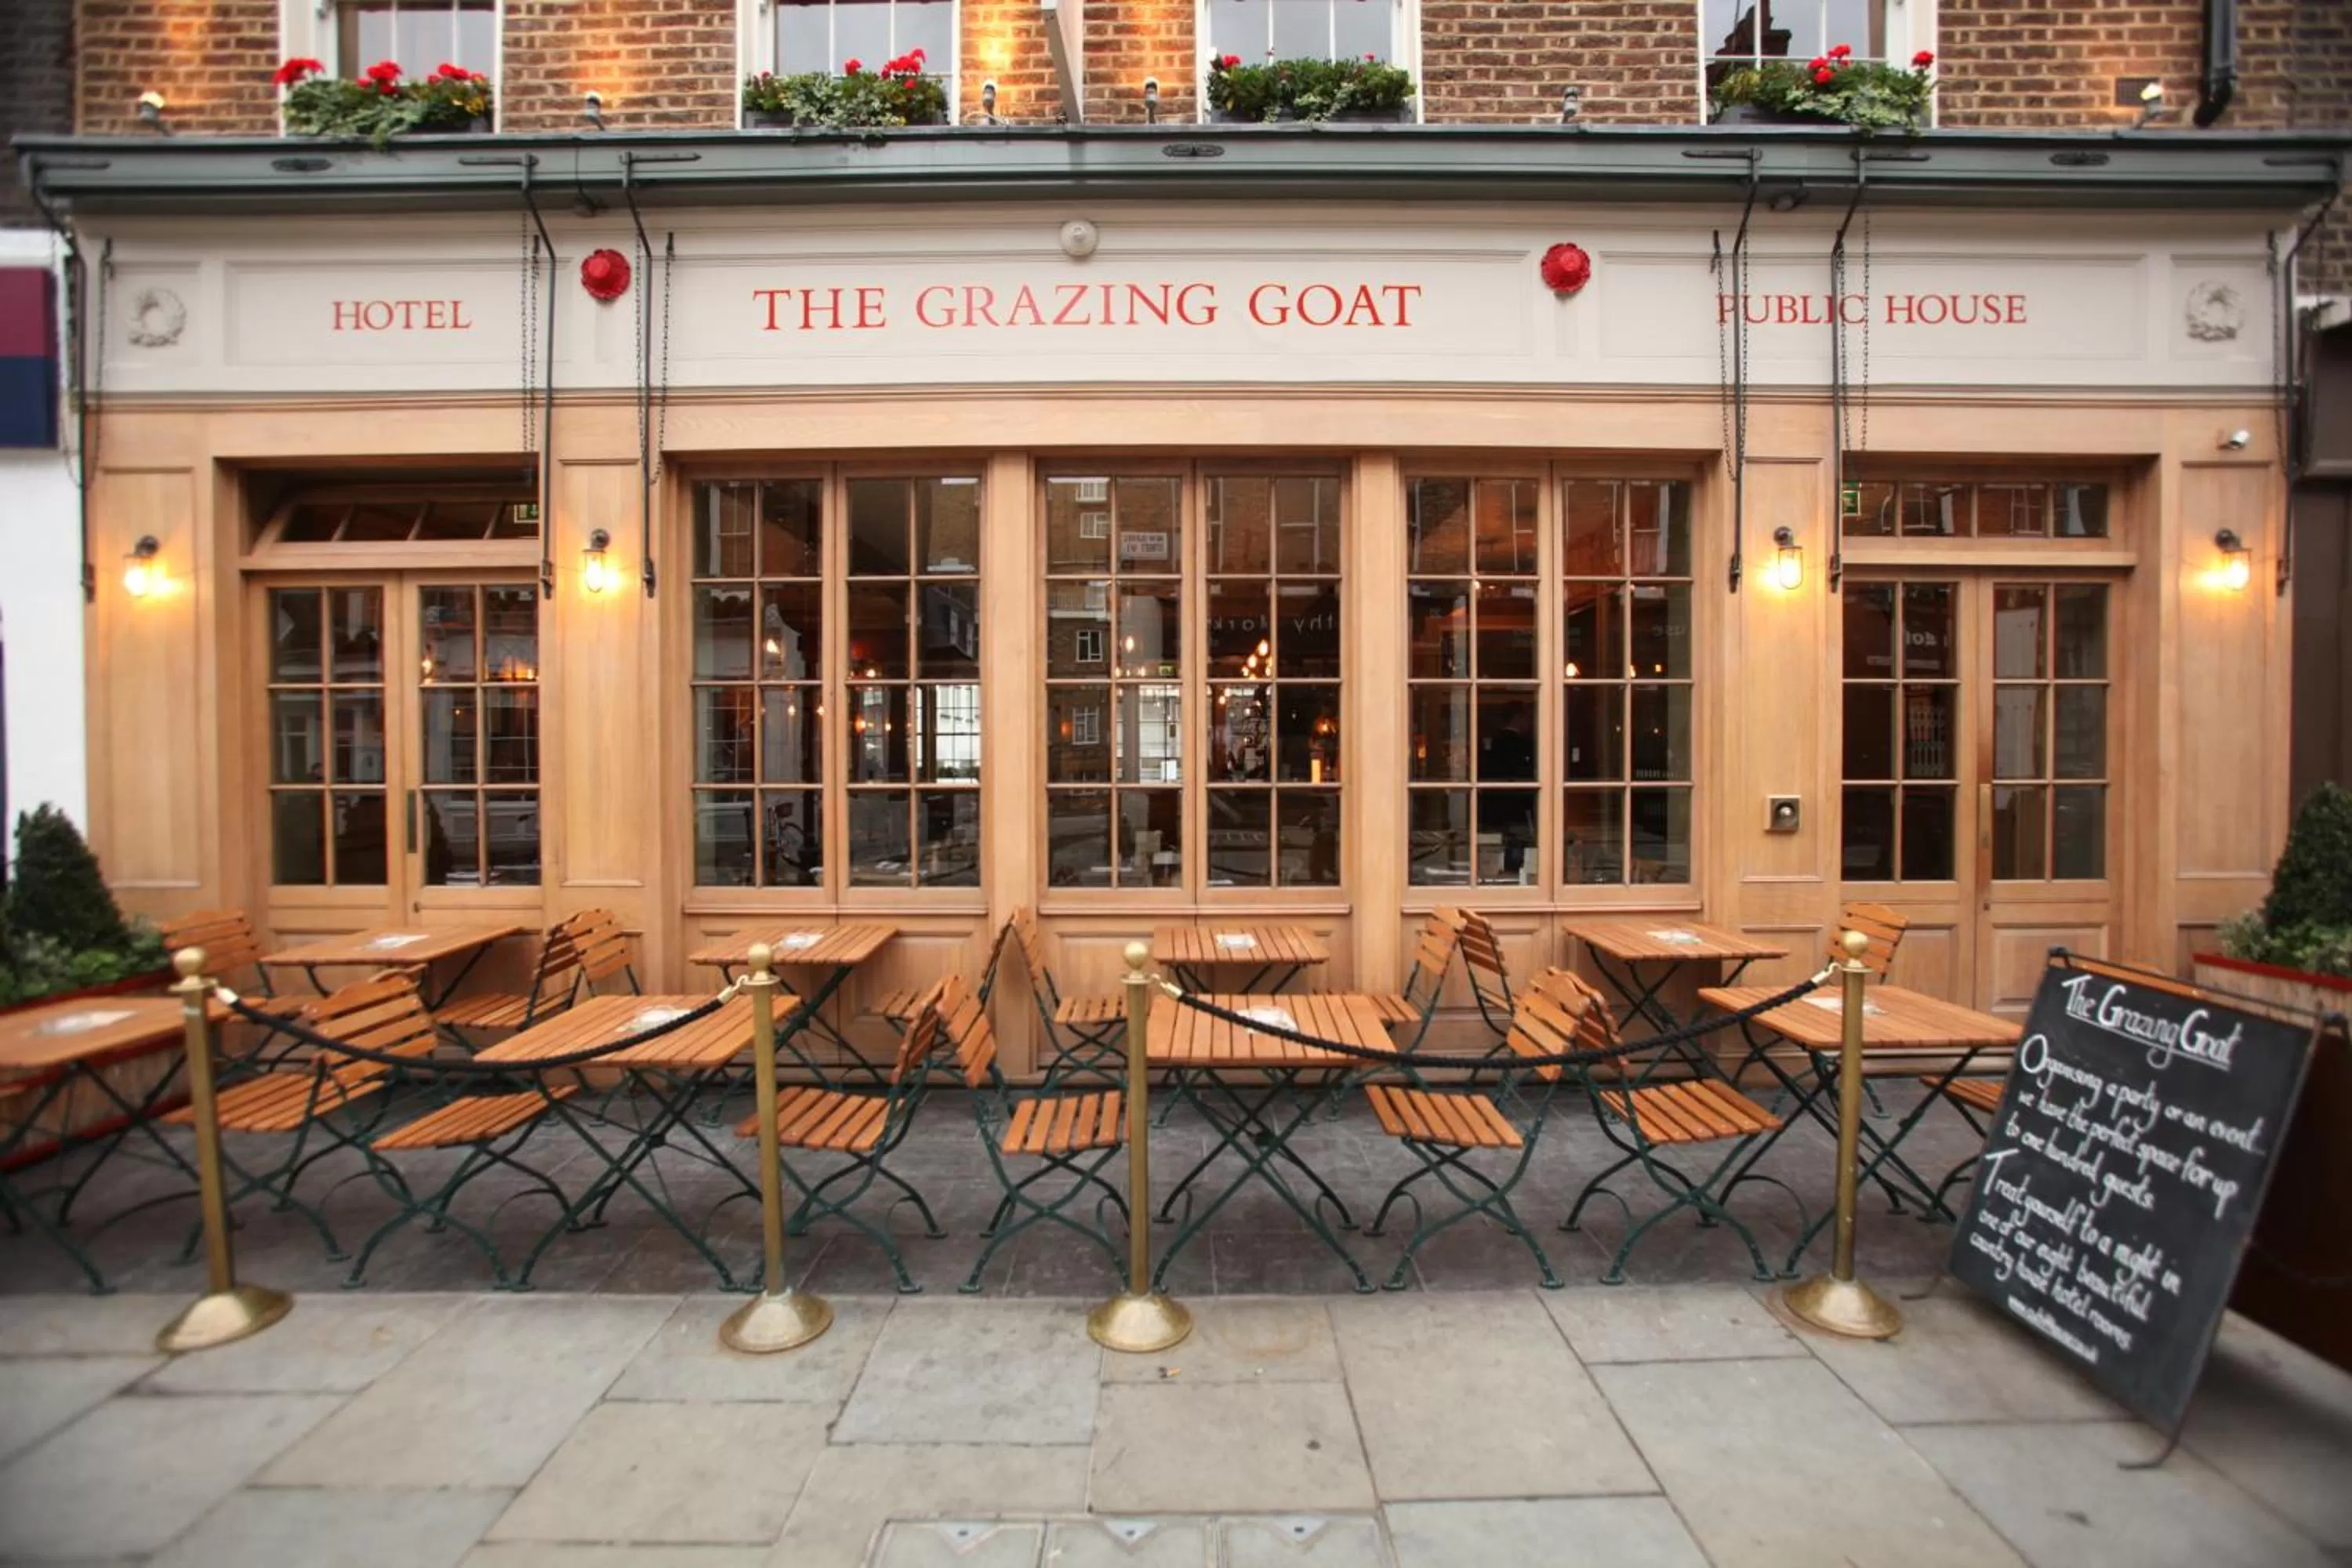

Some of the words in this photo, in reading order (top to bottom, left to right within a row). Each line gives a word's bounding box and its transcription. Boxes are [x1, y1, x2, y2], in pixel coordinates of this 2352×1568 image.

[332, 300, 473, 332] HOTEL
[753, 286, 887, 332] THE
[915, 281, 1218, 327] GRAZING
[1248, 282, 1422, 327] GOAT
[1715, 294, 1867, 325] PUBLIC
[1885, 294, 2027, 325] HOUSE
[2061, 974, 2095, 1018] The
[2097, 984, 2180, 1069] Grazing
[2180, 1009, 2243, 1066] Goat
[2020, 1034, 2104, 1109] Organising
[2111, 1080, 2161, 1134] party
[2164, 1105, 2184, 1120] or
[2183, 1110, 2207, 1132] an
[1984, 1148, 2031, 1205] Treat
[2005, 1110, 2020, 1138] to
[2043, 1127, 2105, 1184] hundred
[2038, 1090, 2068, 1122] have
[2067, 1100, 2091, 1131] the
[2082, 1115, 2141, 1154] perfect
[2136, 1142, 2183, 1174] space
[2181, 1145, 2214, 1189] for
[2212, 1178, 2240, 1221] up
